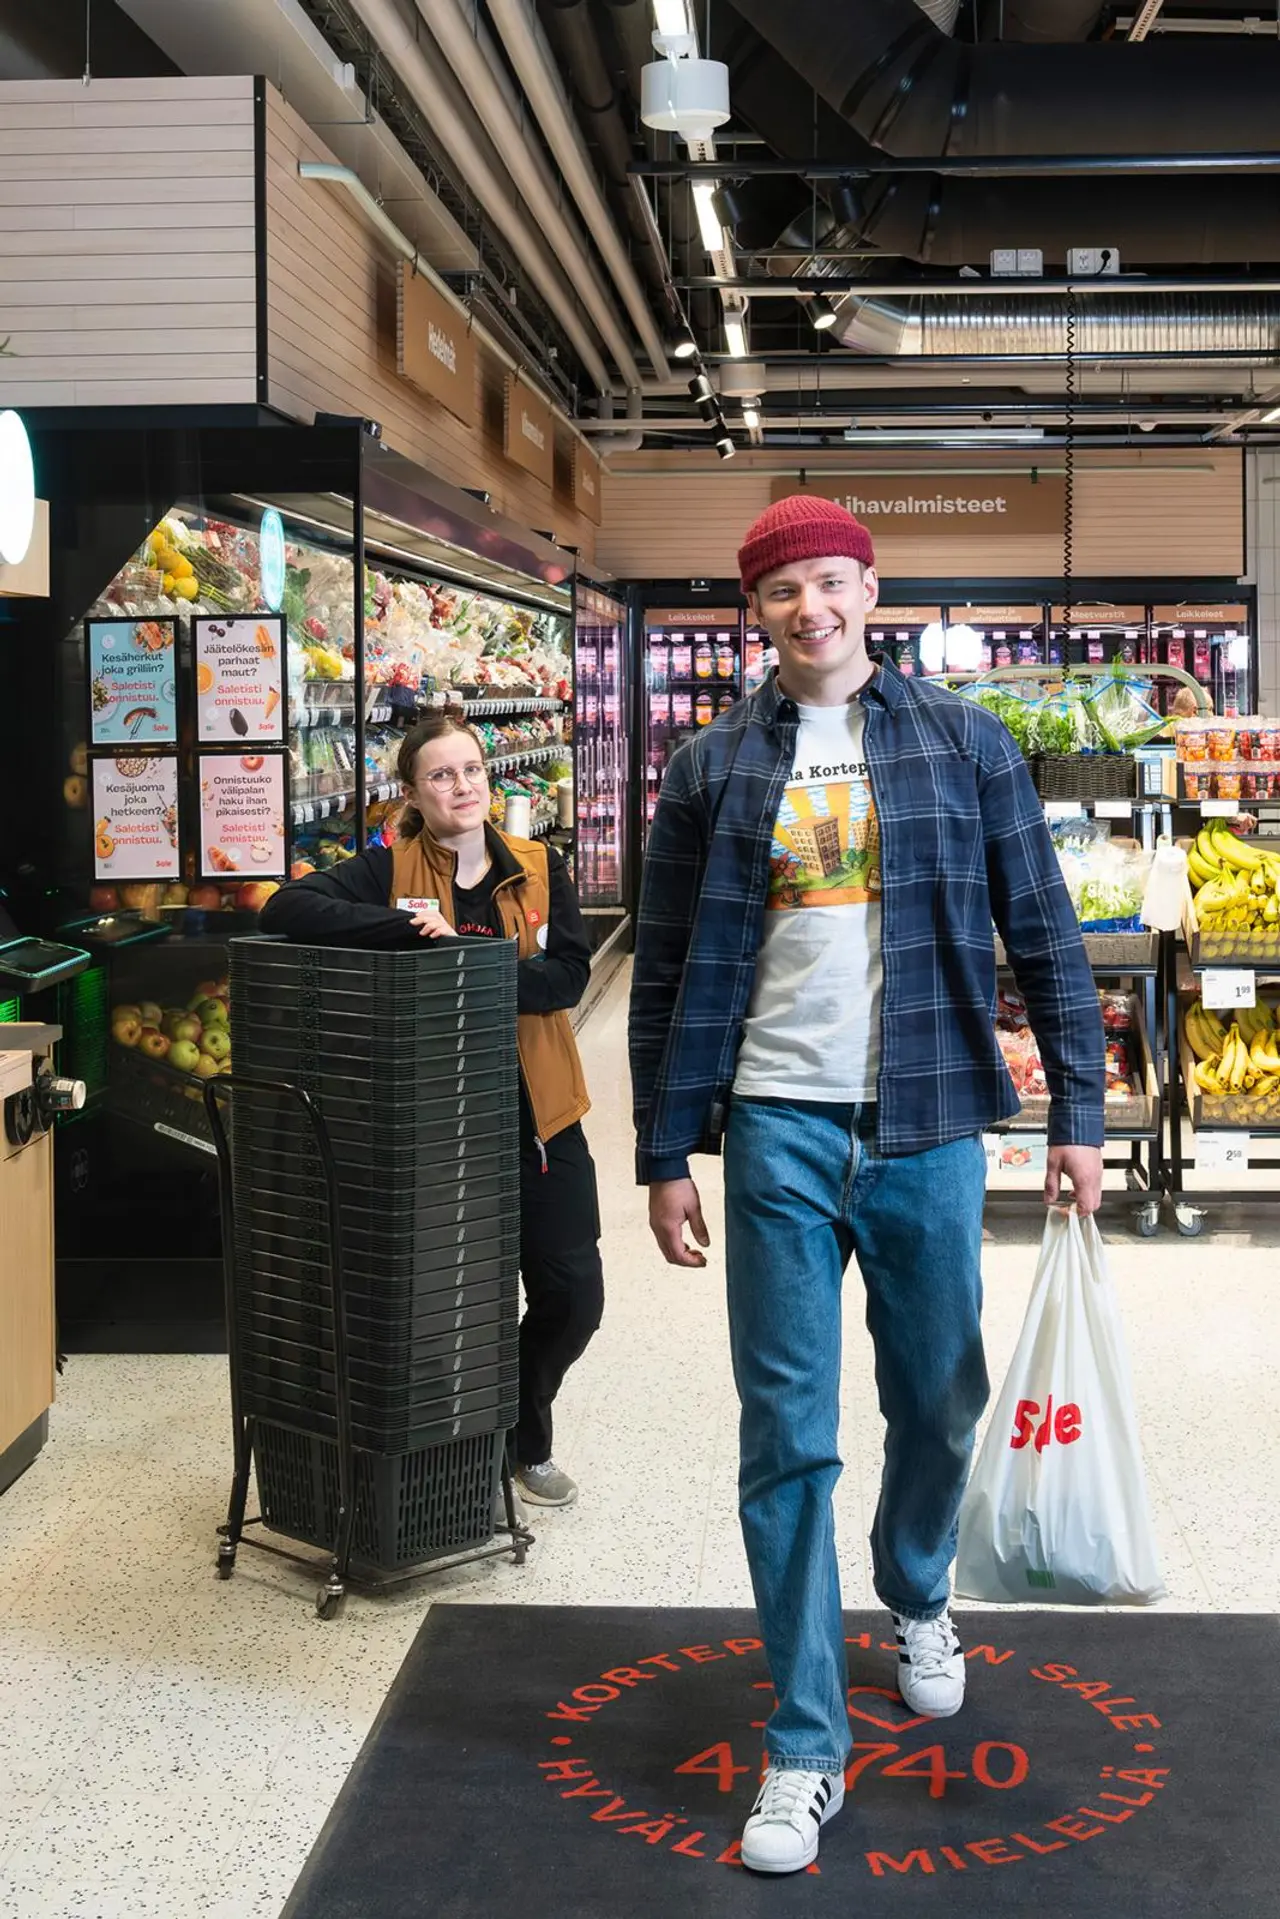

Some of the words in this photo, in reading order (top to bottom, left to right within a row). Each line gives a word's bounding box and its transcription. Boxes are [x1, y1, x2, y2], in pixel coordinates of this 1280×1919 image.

[101, 653, 164, 662] Kesäherkut
[218, 656, 261, 667] parhaat
[100, 665, 124, 680] joka
[126, 663, 165, 676] grilliin?
[221, 667, 258, 677] maut?
[111, 681, 156, 691] Saletisti
[217, 684, 263, 694] Saletisti
[109, 692, 160, 703] onnistuu.
[214, 695, 265, 706] onnistuu.
[808, 761, 869, 779] Kortep
[213, 775, 272, 785] Onnistuuko
[106, 782, 166, 794] Kesäjuoma
[221, 785, 265, 796] välipalan
[124, 794, 147, 806] joka
[219, 796, 244, 806] haku
[245, 796, 268, 805] ihan
[110, 806, 162, 816] hetkeen?
[215, 807, 271, 818] pikaisesti?
[115, 822, 160, 833] Saletisti
[222, 822, 266, 832] Saletisti
[112, 834, 162, 845] onnistuu.
[219, 833, 269, 843] onnistuu.
[1029, 1662, 1162, 1731] SALE
[674, 1741, 1030, 1799] 4740
[864, 1765, 1172, 1877] MIELELLÄ
